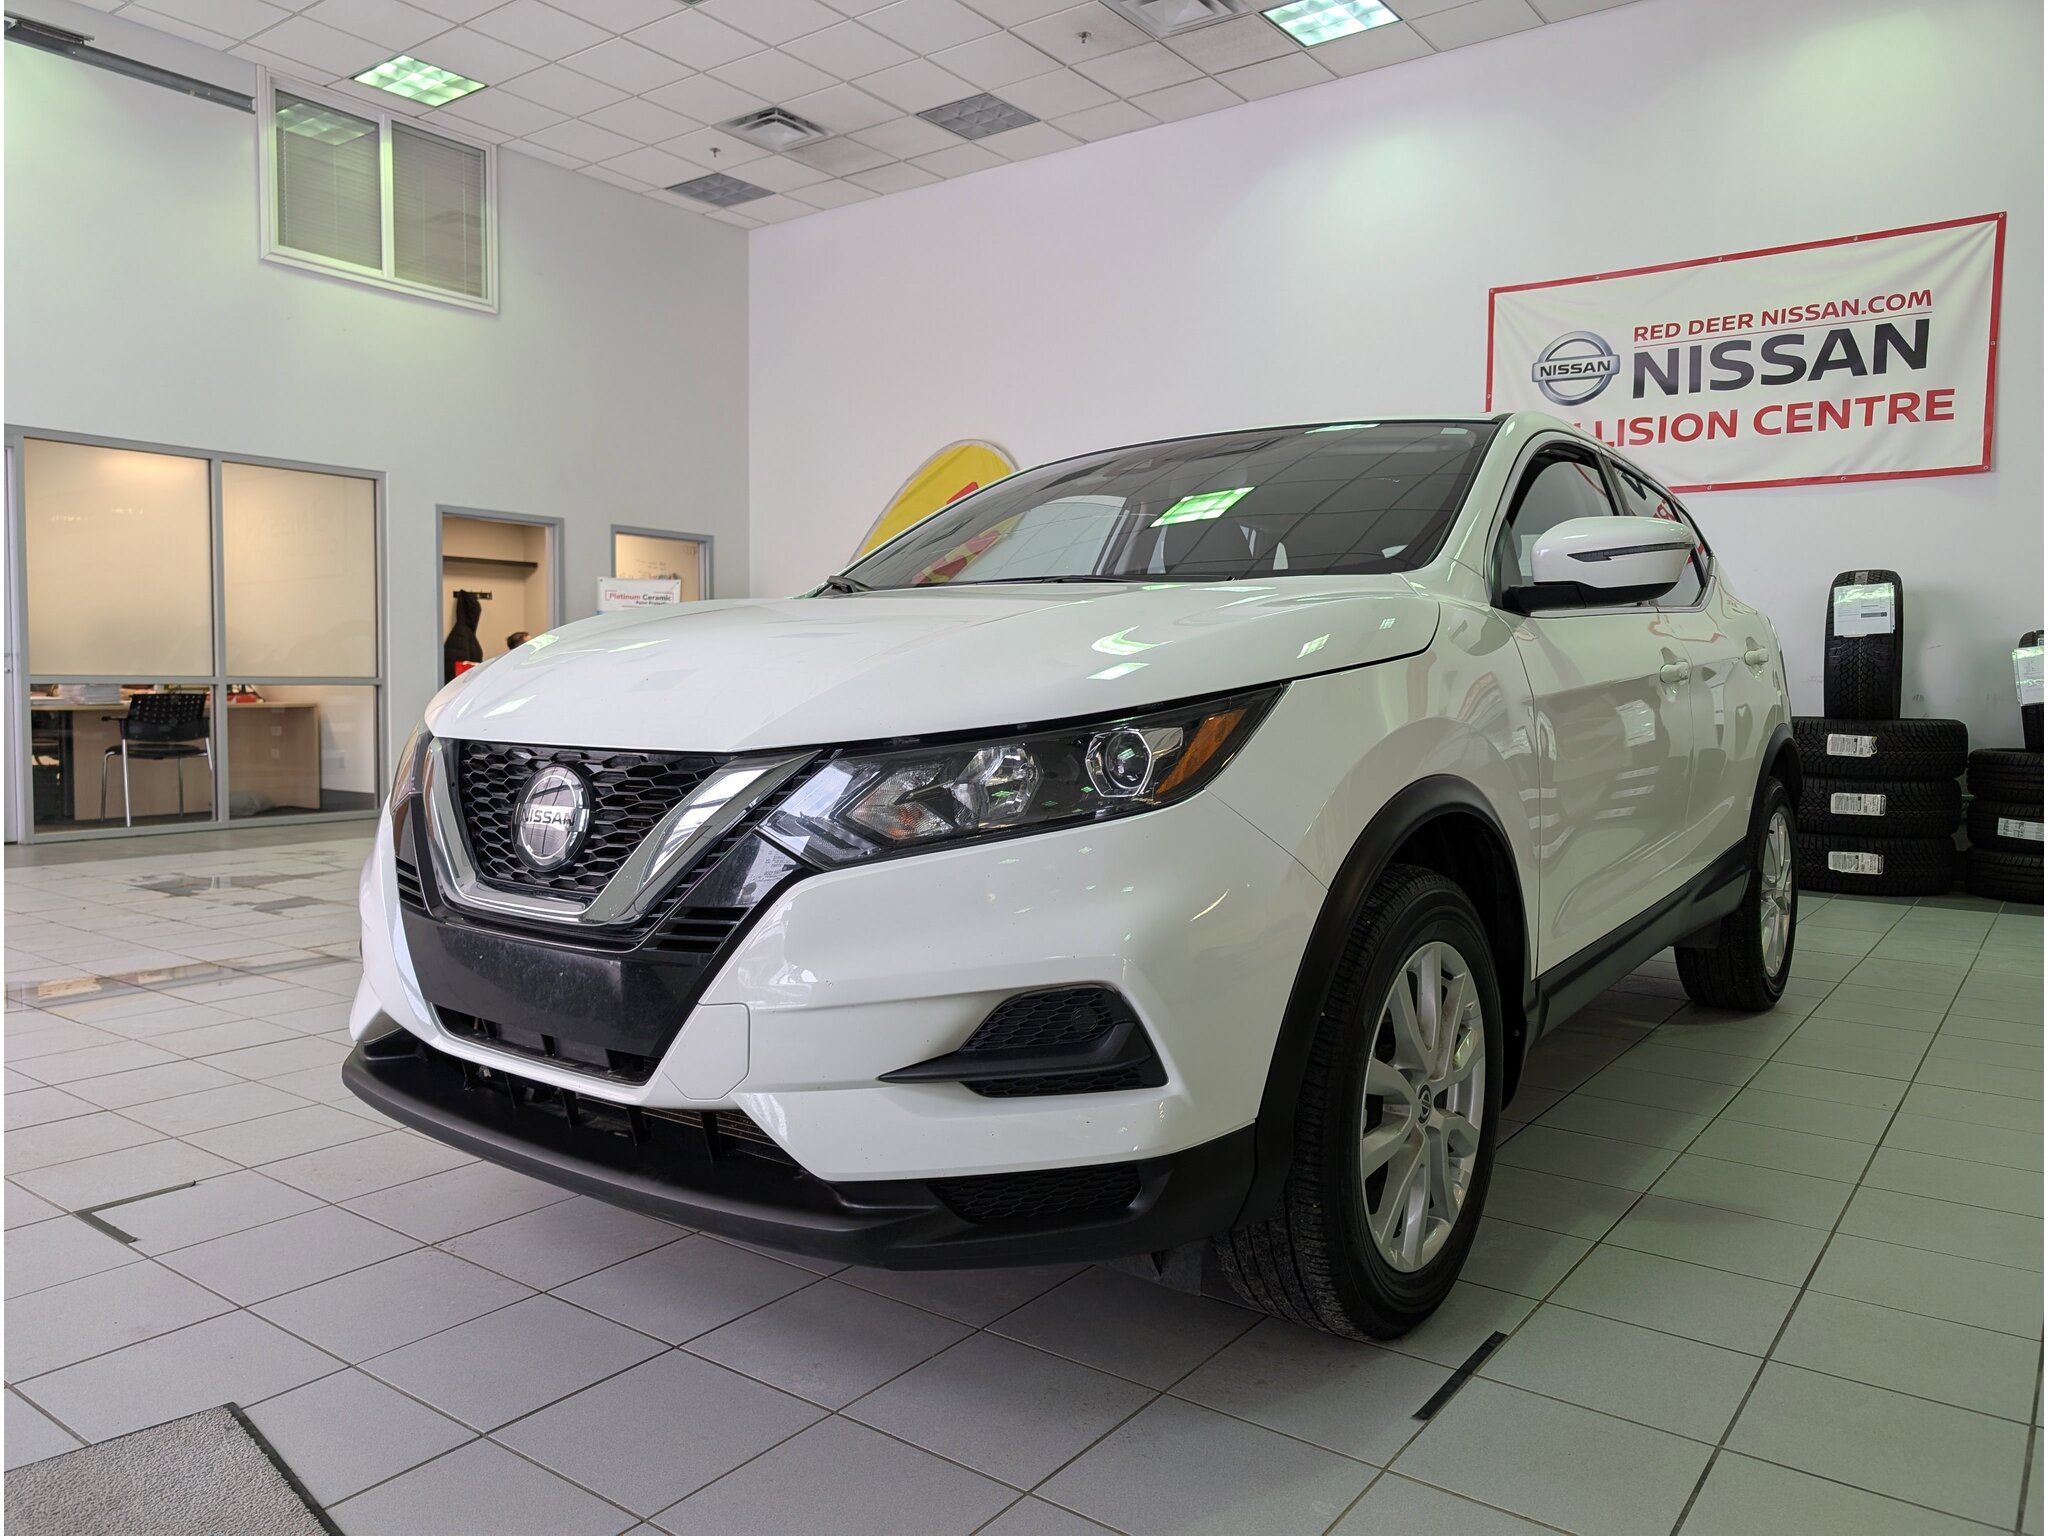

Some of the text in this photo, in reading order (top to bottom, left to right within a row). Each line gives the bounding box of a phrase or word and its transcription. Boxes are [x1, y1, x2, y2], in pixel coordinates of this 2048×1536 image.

[1633, 289, 1932, 341] RED DEER NISSAN.COM
[1540, 360, 1611, 378] NISSAN
[1632, 318, 1930, 399] NISSAN
[1573, 388, 1955, 448] LISION CENTRE
[609, 592, 640, 600] Platinum
[520, 808, 577, 826] NISSAN
